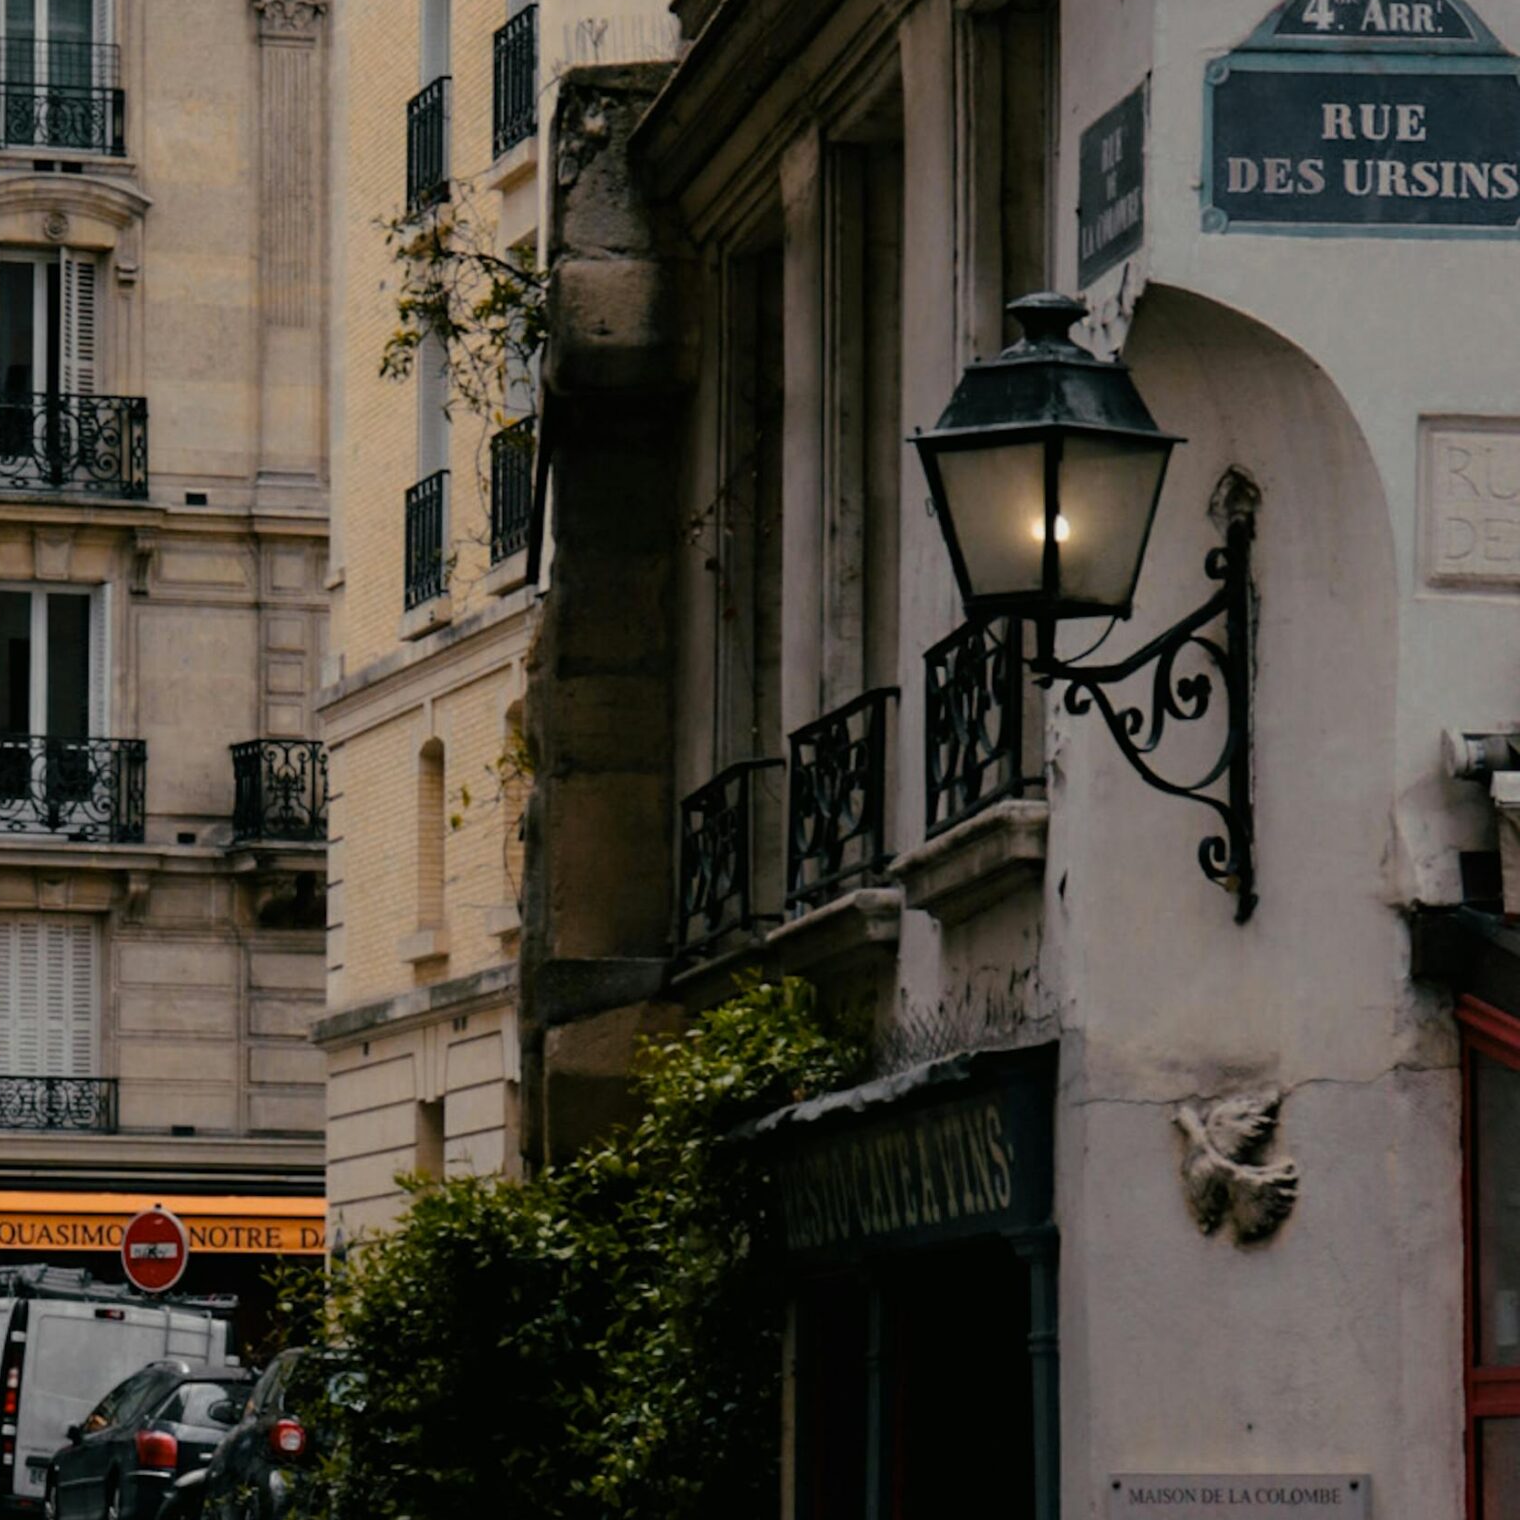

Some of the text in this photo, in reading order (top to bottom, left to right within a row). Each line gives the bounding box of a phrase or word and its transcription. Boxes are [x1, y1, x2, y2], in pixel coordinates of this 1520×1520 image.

[1321, 103, 1427, 141] RUE
[1227, 157, 1519, 200] DES URSINS
[189, 1225, 283, 1249] NOTRE
[1128, 1487, 1343, 1507] MAISON DE LA COLOMBE
